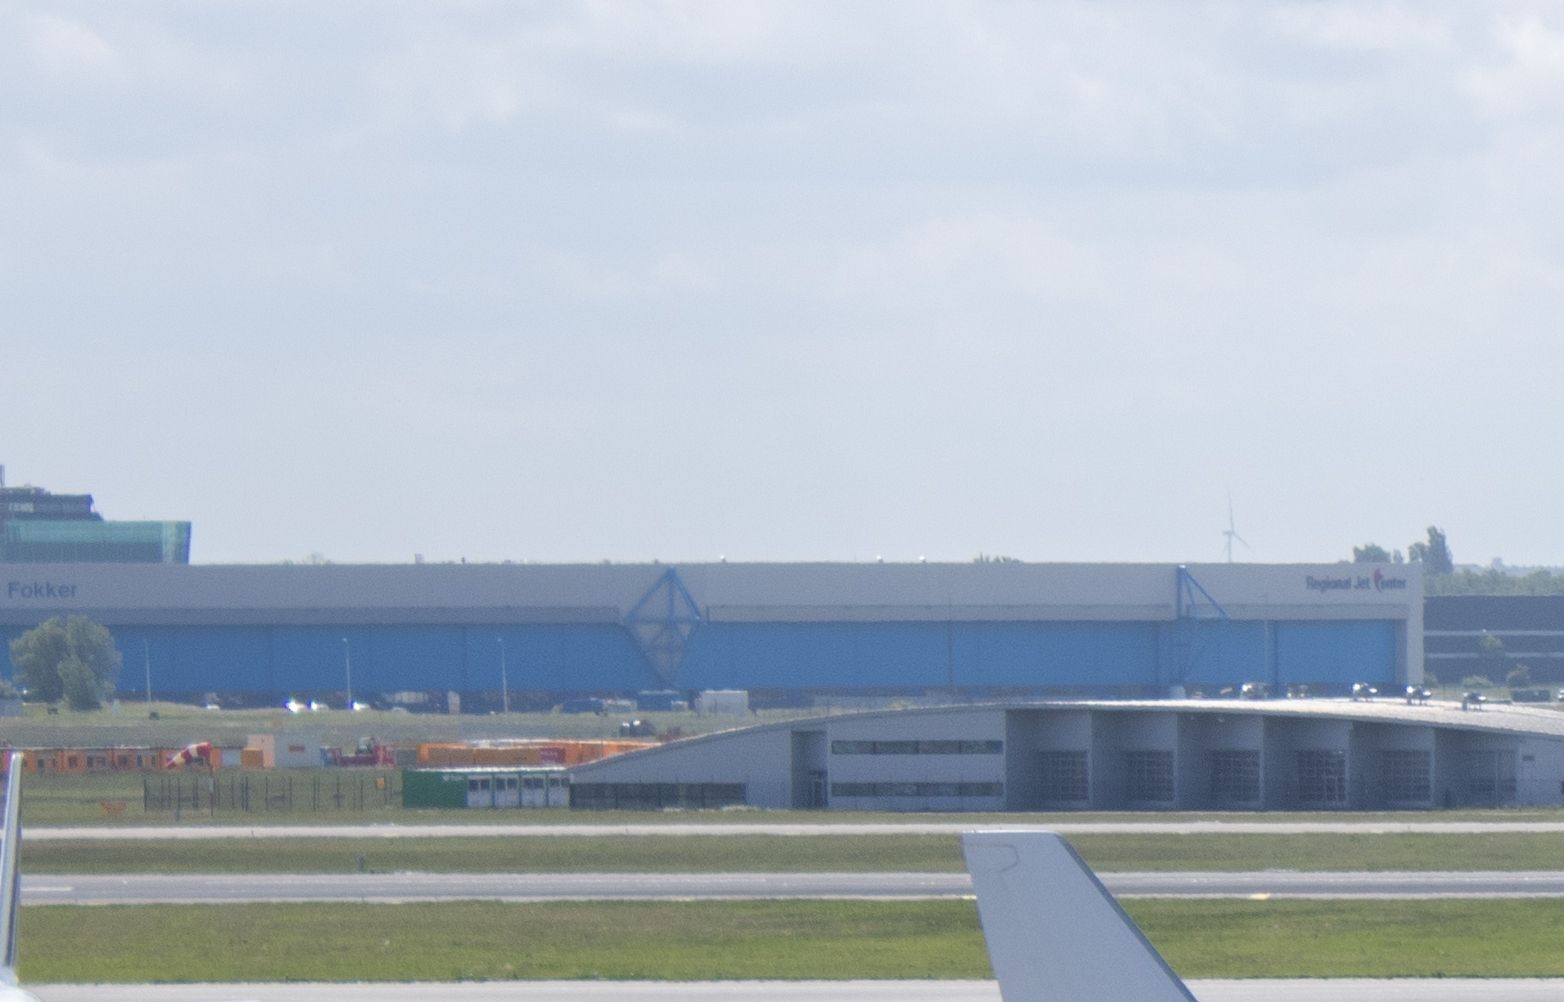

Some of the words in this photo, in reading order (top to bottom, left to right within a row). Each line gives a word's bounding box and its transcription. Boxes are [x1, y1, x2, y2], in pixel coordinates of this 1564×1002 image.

[8, 581, 78, 598] Fokker
[1306, 576, 1351, 592] Regional
[1353, 576, 1370, 590] Jet
